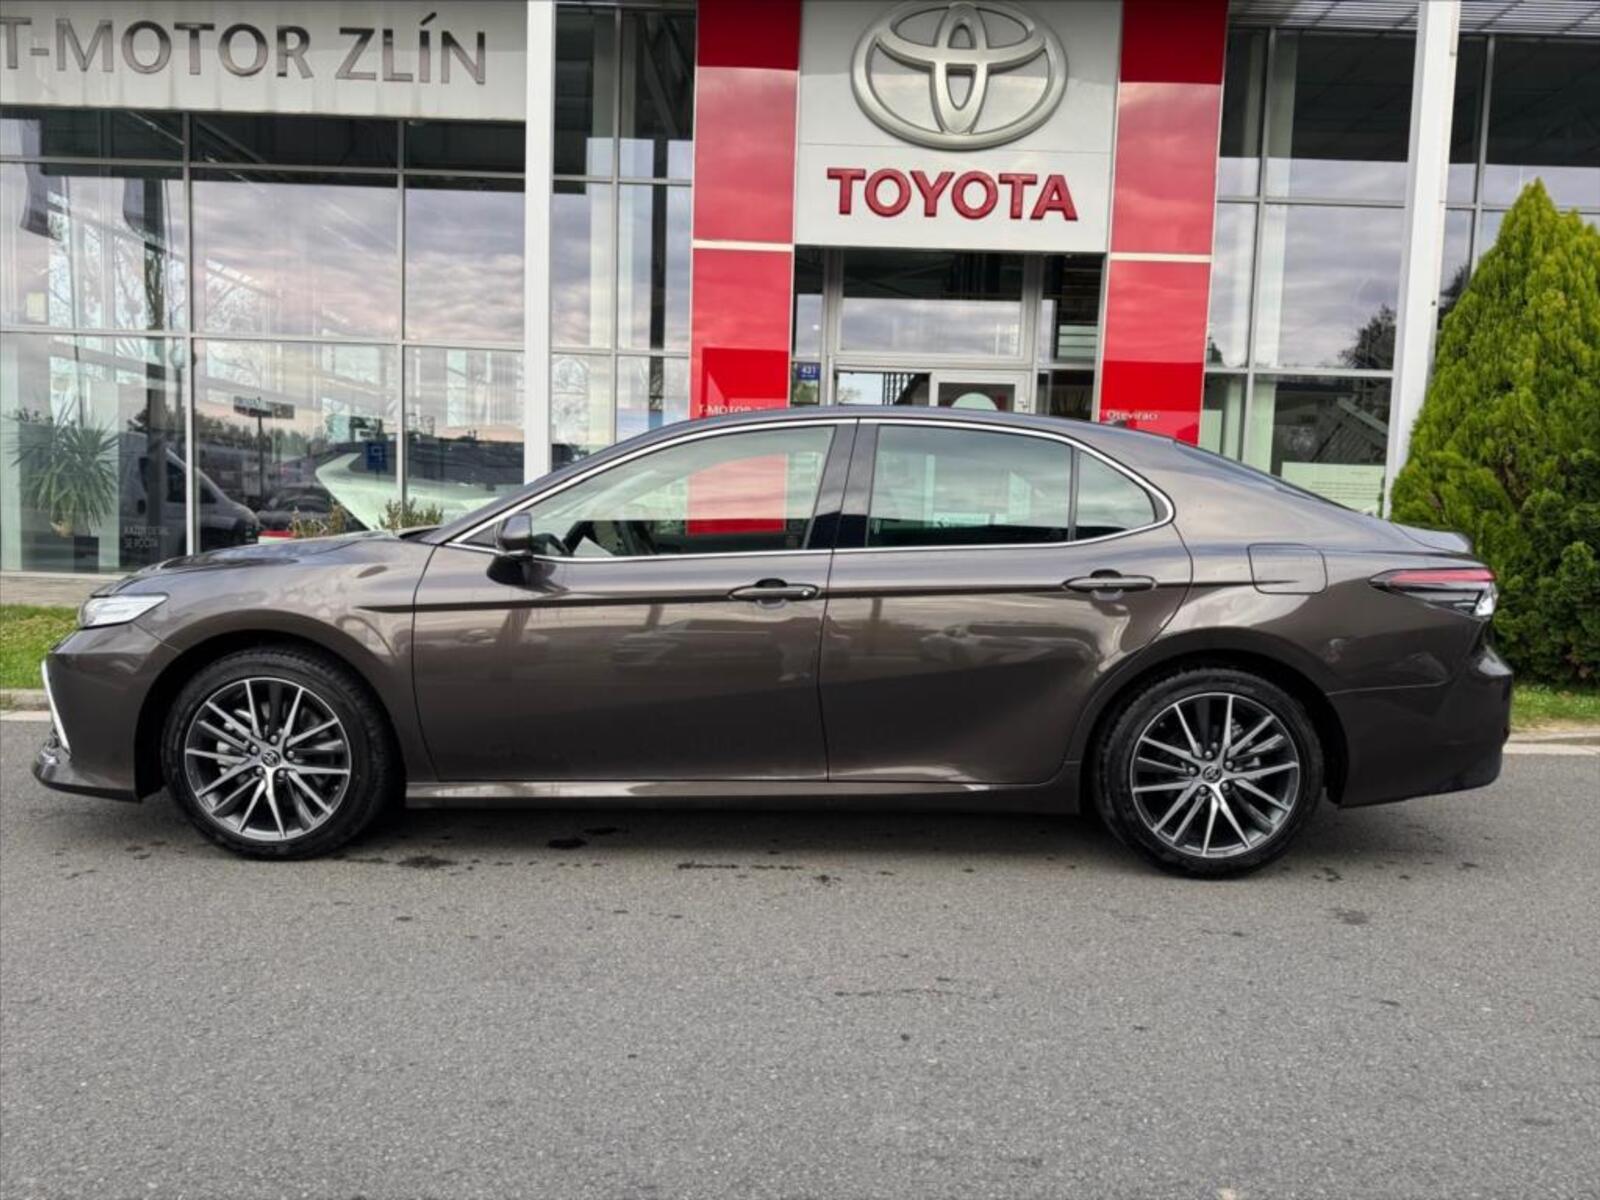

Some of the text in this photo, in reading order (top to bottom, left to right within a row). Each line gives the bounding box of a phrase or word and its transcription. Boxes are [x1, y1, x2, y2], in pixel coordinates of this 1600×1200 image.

[0, 11, 487, 85] T-MOTOR ZLÍN
[827, 167, 1079, 222] TOYOTA
